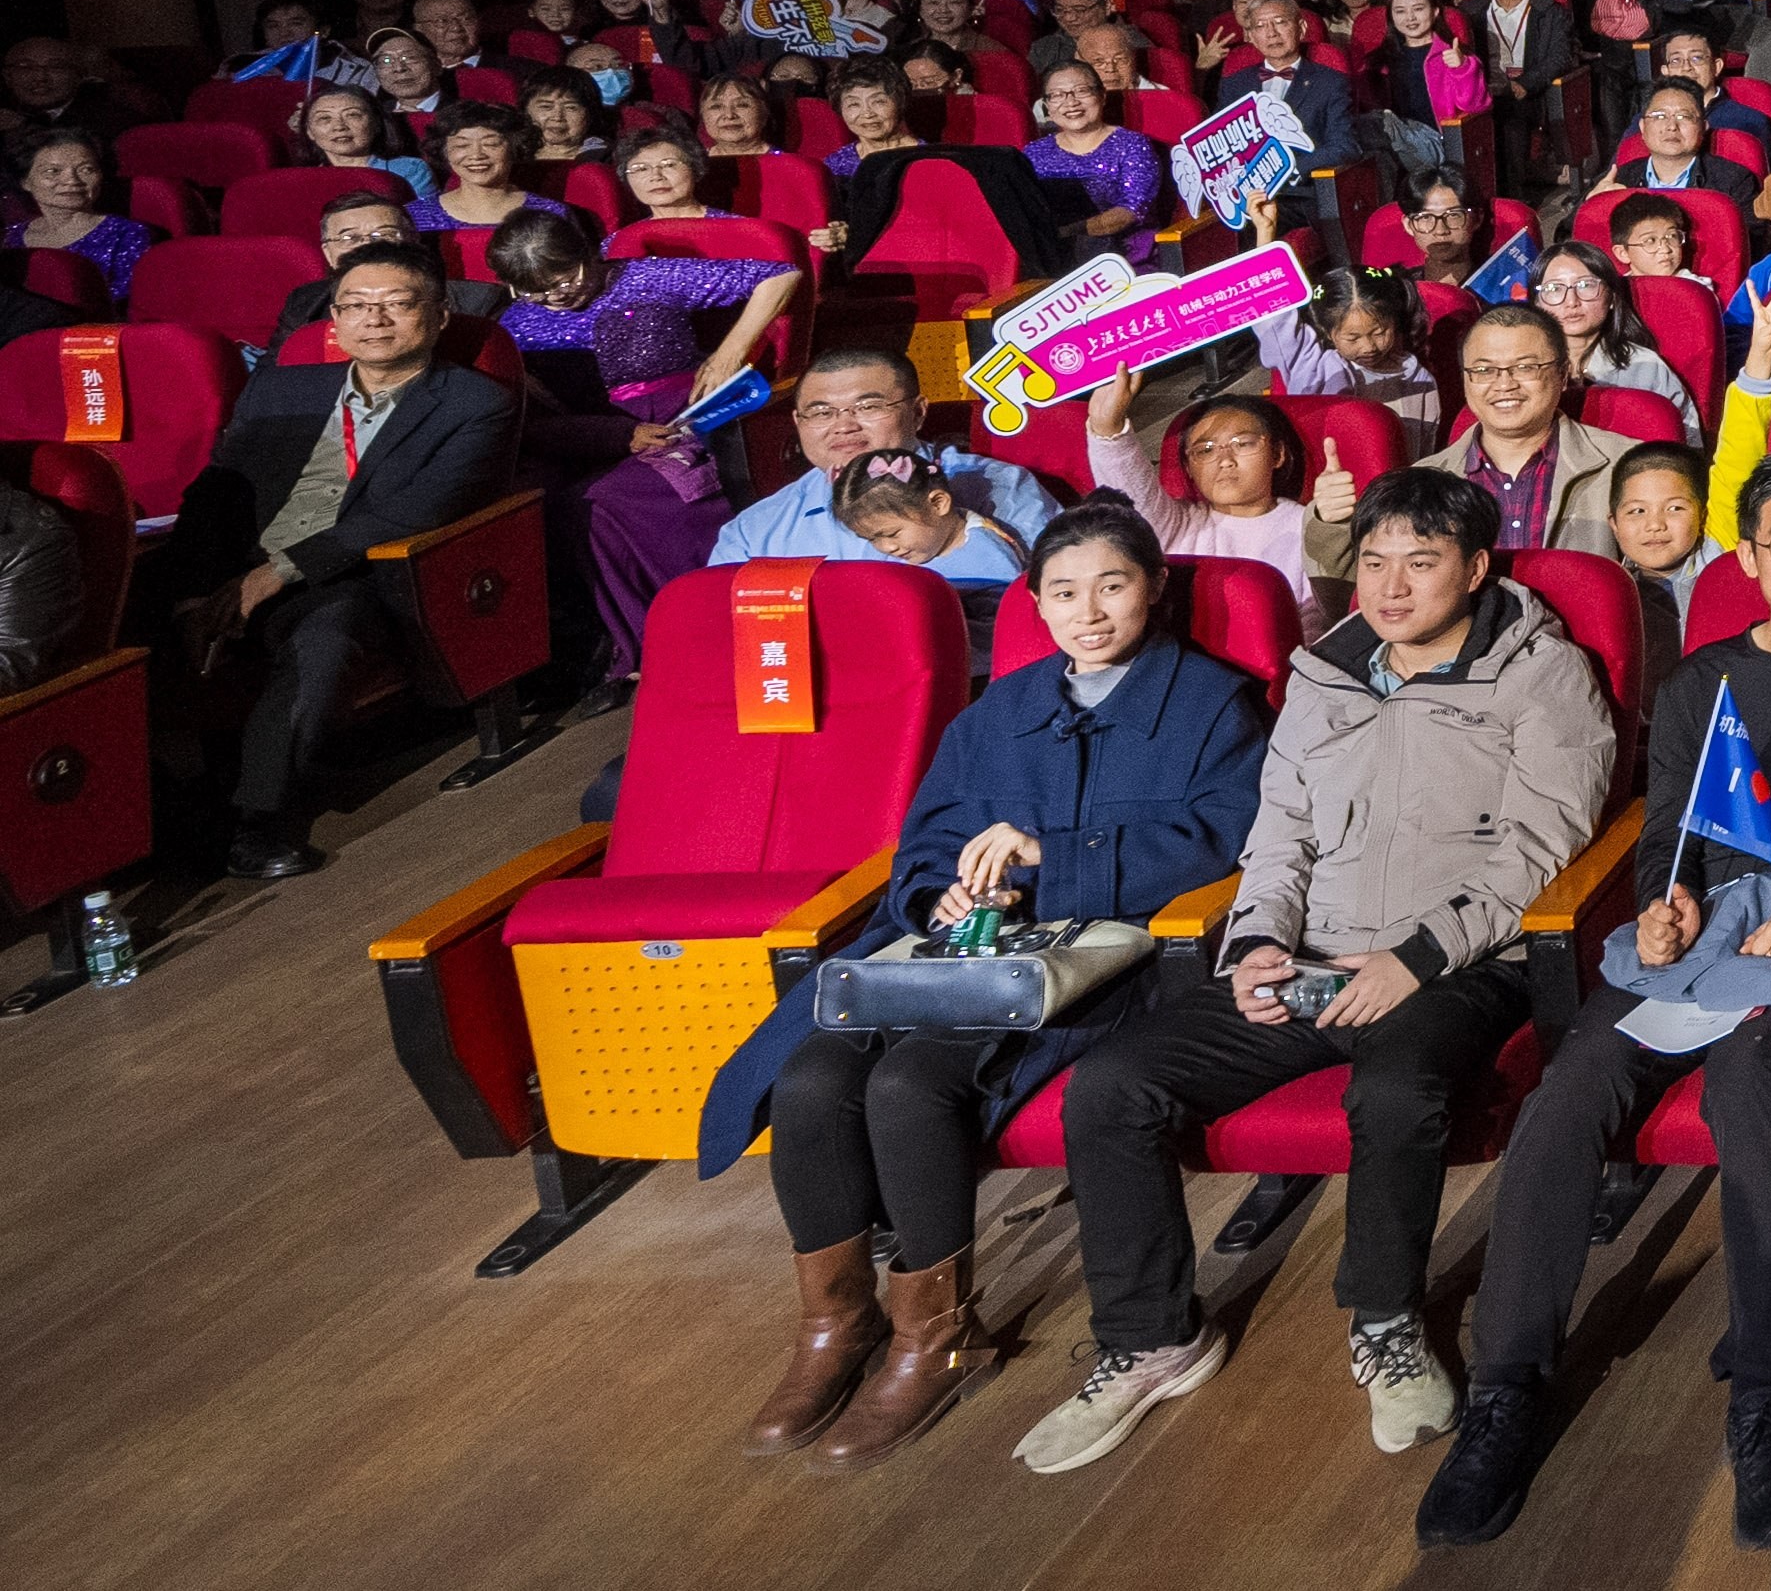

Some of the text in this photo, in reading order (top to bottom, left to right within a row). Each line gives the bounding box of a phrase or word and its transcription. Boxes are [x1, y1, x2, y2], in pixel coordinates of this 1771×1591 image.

[1017, 271, 1113, 341] SJTUME
[1178, 266, 1286, 318] 机械与动力工程学院
[81, 368, 107, 426] 孙远祥
[759, 640, 790, 704] 嘉宾
[1727, 767, 1742, 793] I
[653, 944, 671, 956] 10
